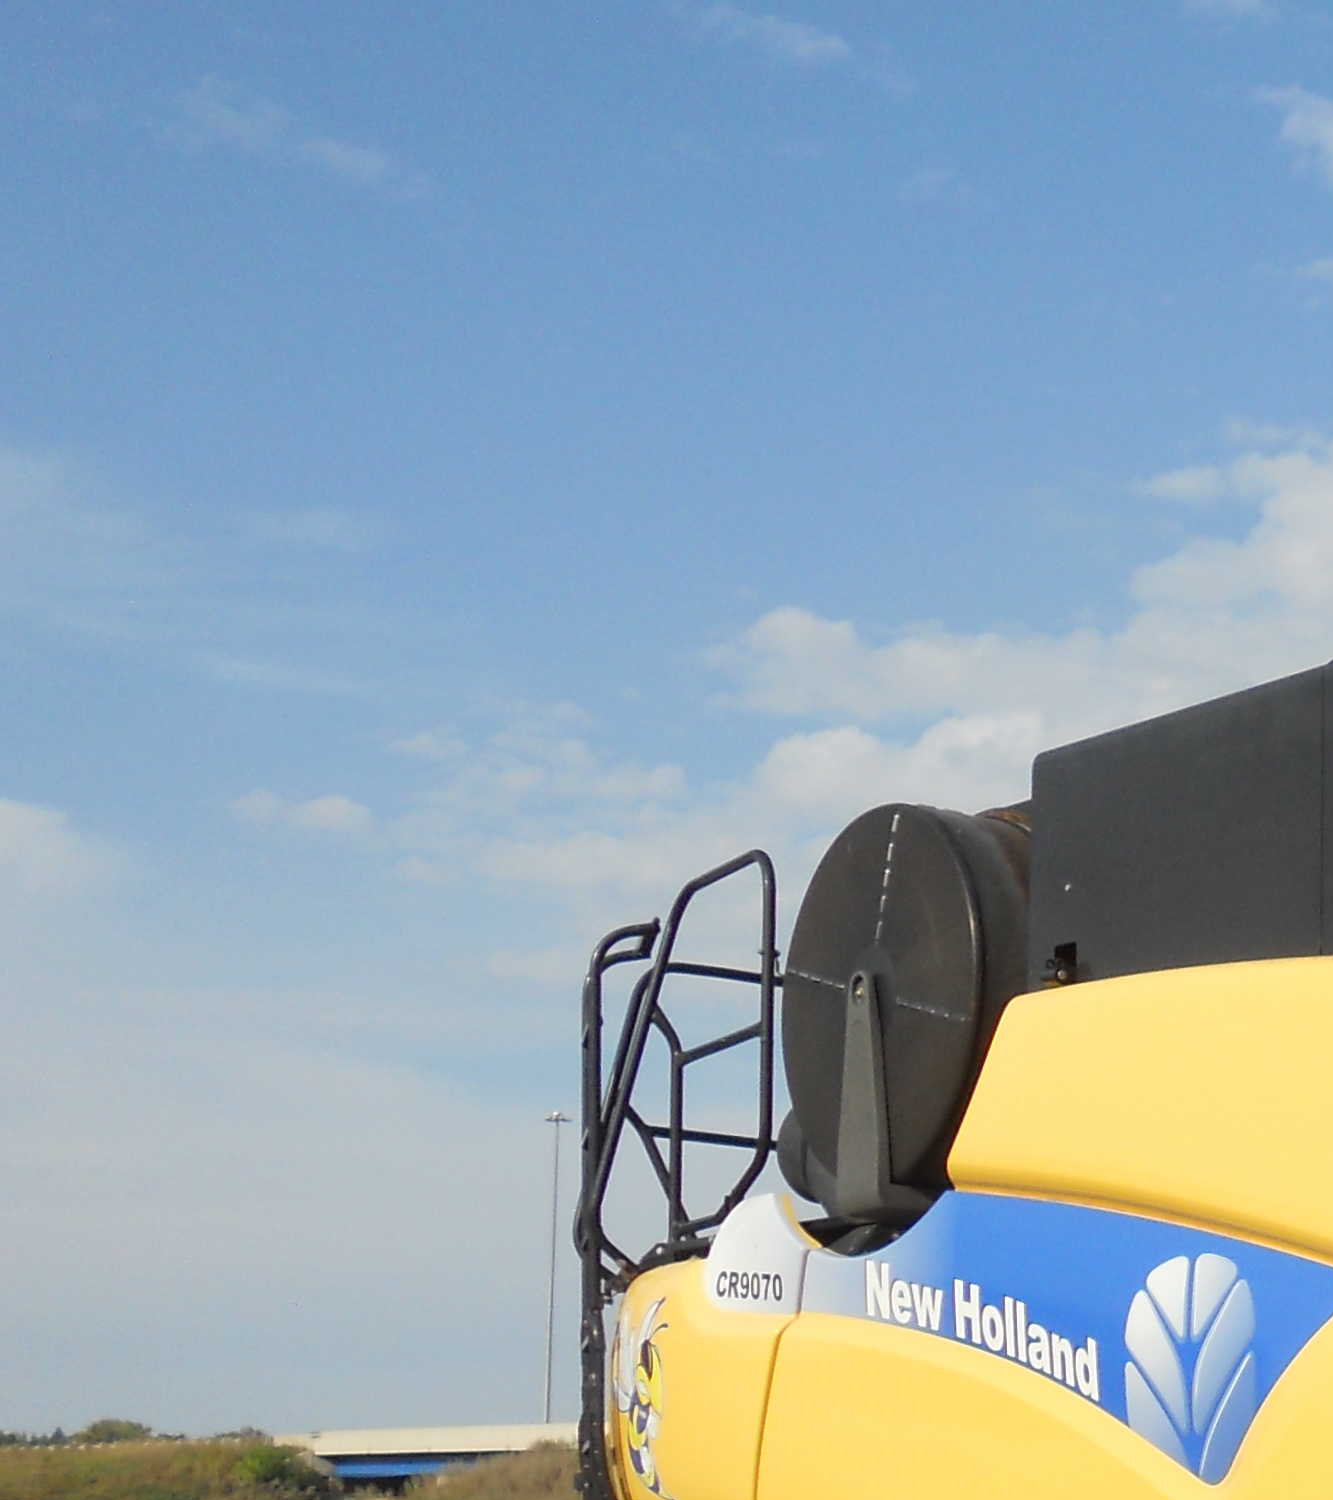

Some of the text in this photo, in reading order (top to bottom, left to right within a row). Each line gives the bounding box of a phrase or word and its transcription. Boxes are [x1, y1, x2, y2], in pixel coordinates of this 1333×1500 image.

[716, 1271, 783, 1302] CR9070
[866, 1260, 1099, 1402] New Holland
